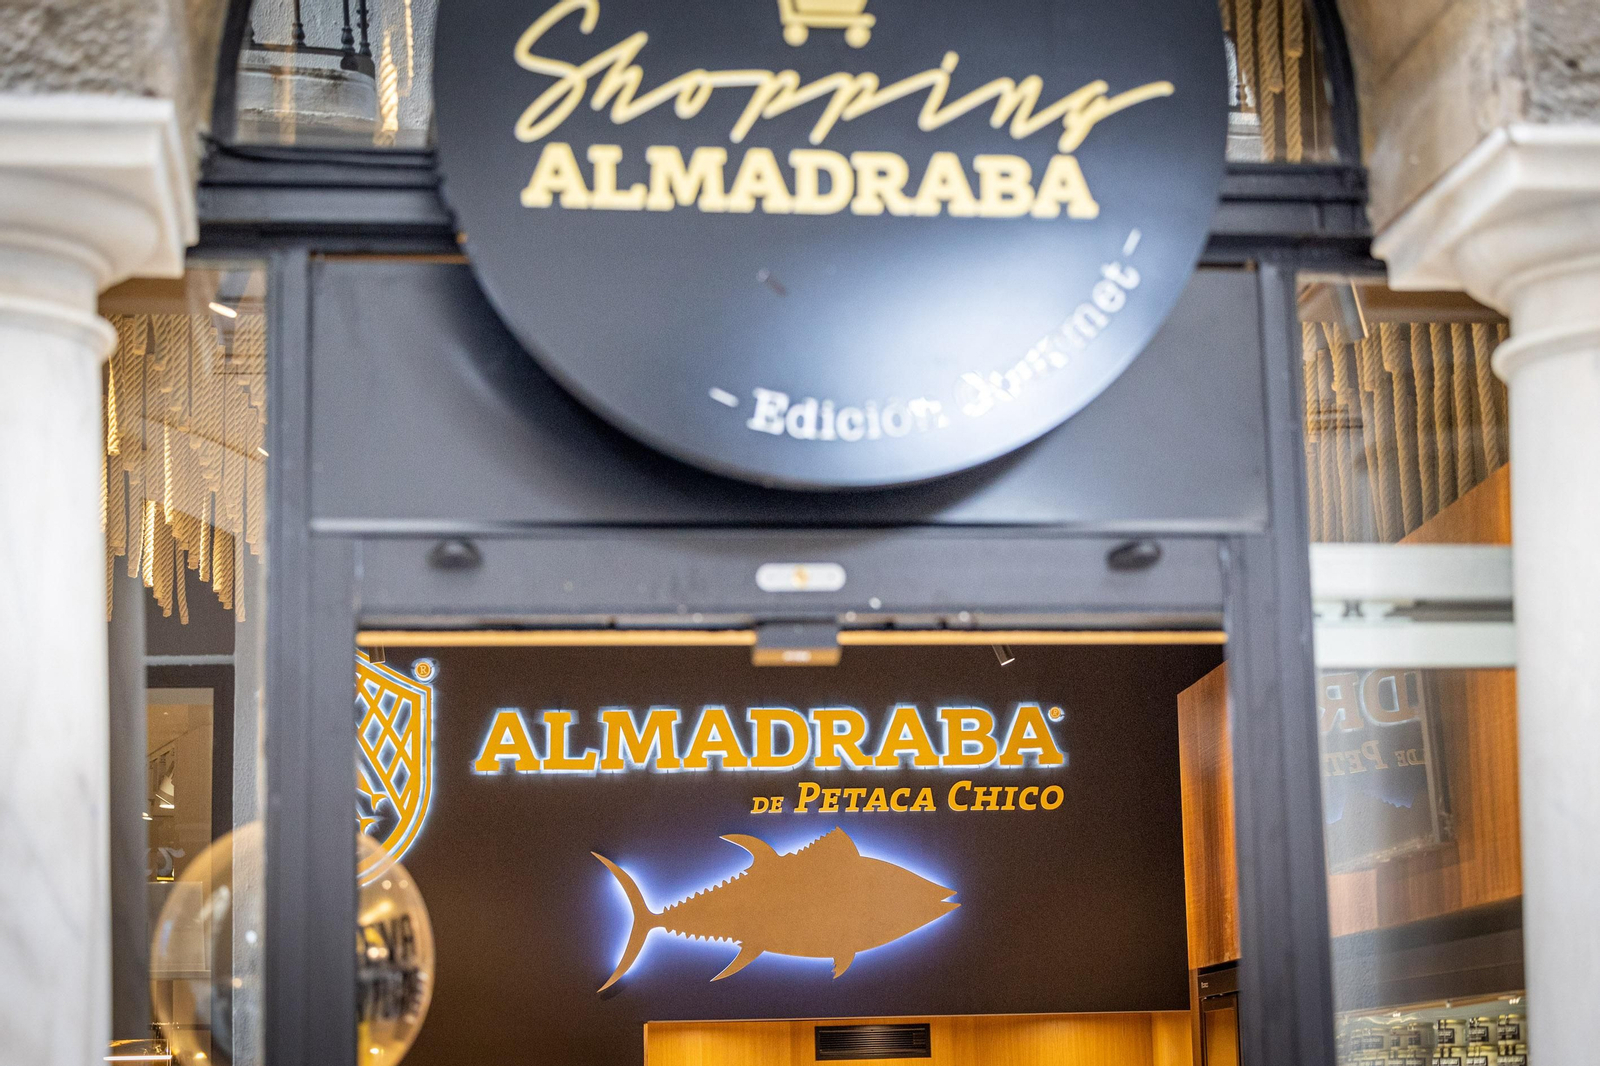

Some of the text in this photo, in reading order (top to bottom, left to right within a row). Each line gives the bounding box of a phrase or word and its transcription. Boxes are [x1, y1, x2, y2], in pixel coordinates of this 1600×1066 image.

[514, 0, 1175, 153] Shopping
[521, 142, 1099, 218] ALMADRABA
[751, 780, 1065, 814] DE PETACA CHICO
